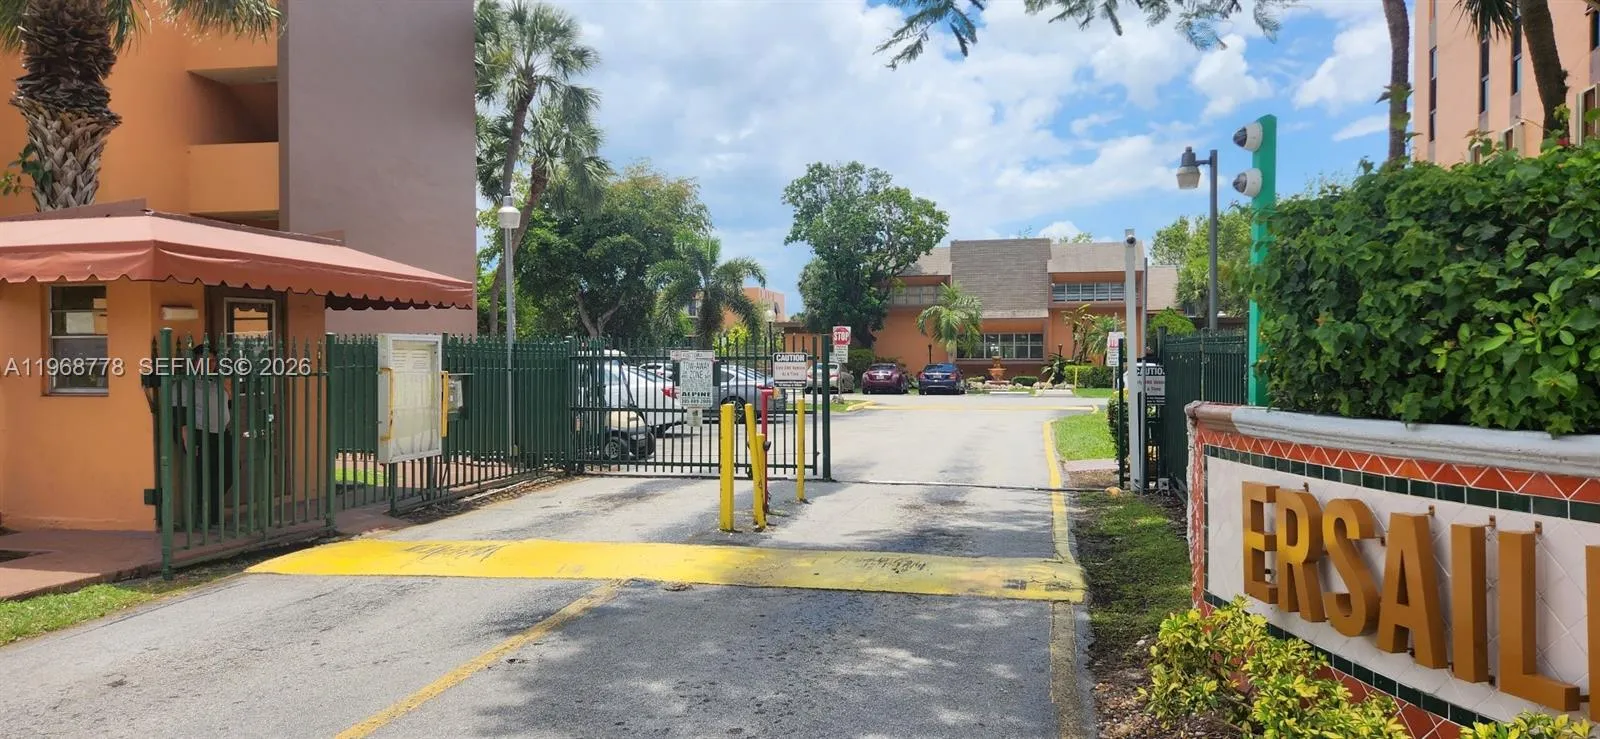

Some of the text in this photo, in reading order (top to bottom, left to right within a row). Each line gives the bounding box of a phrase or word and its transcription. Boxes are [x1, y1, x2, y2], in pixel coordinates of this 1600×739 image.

[833, 331, 849, 341] STOP
[776, 354, 805, 362] CAUTION
[689, 370, 703, 379] ZONE
[1242, 481, 1600, 723] ERSAIL
